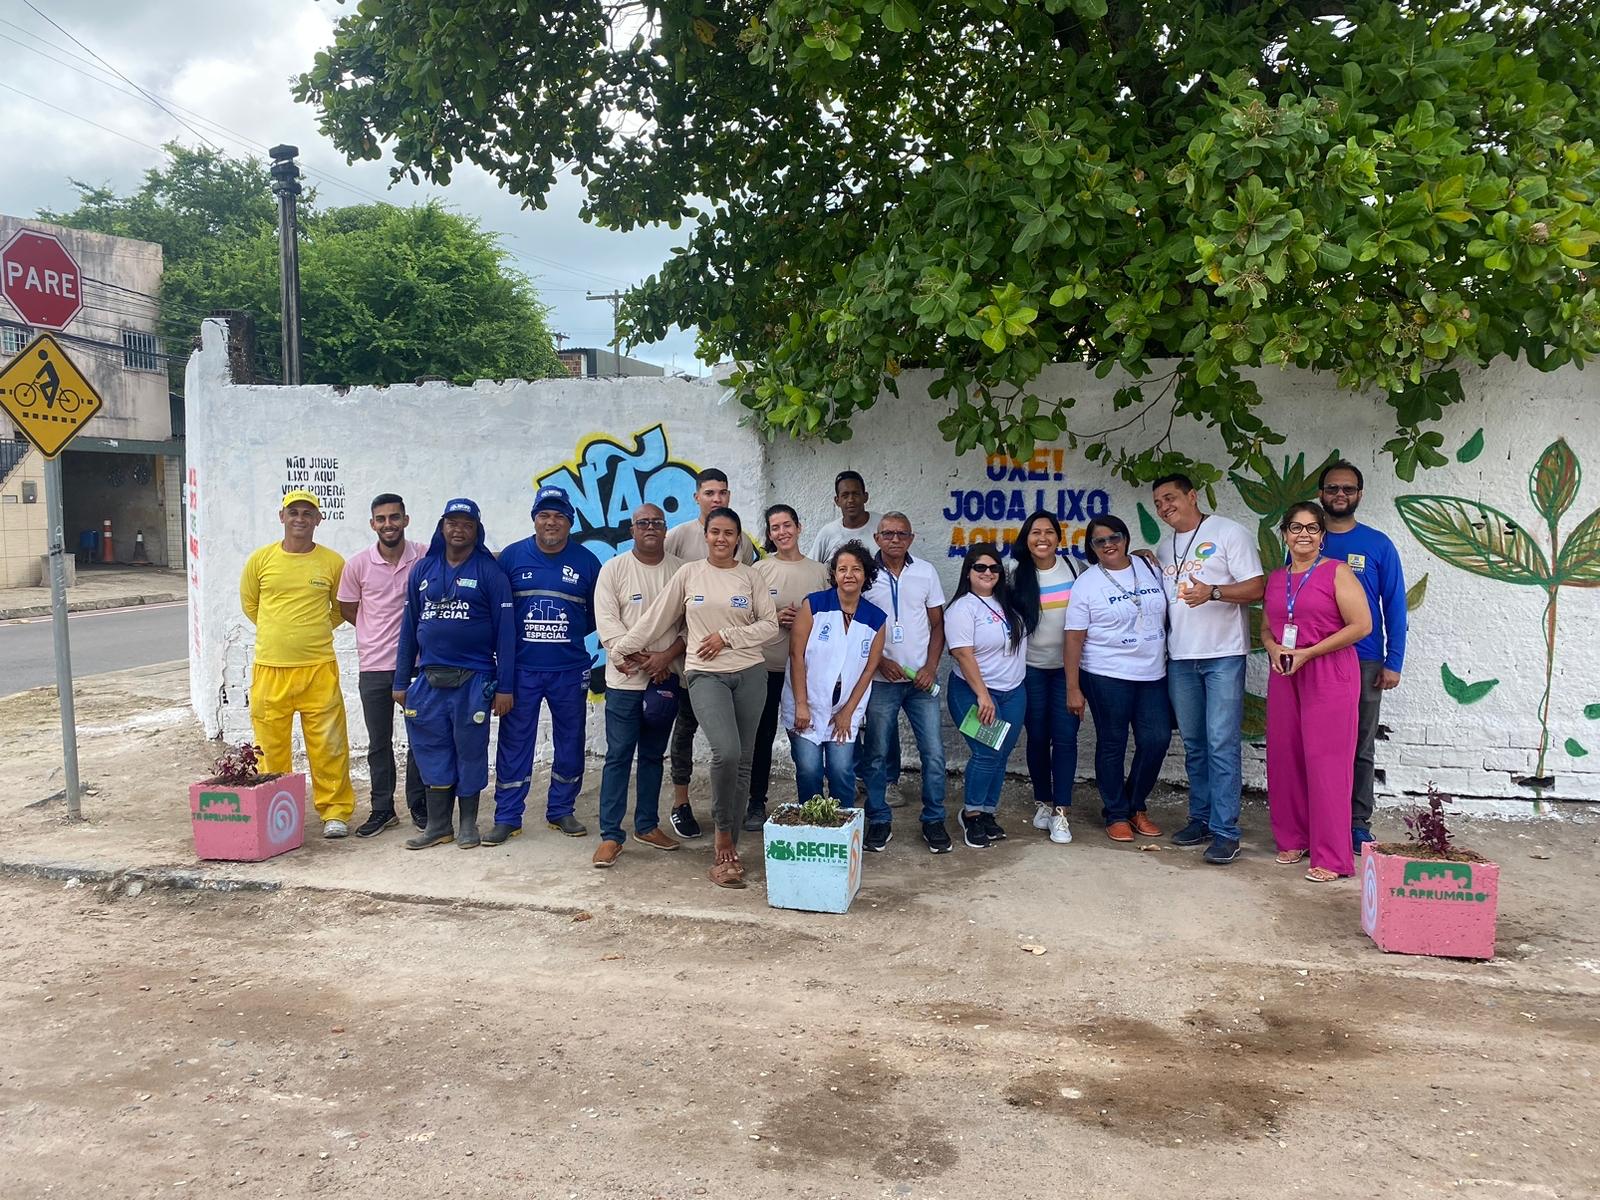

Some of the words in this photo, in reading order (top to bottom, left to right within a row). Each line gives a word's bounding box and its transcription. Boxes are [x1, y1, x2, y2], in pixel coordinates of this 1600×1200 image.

[7, 261, 76, 299] PARE
[286, 456, 306, 469] NÃO
[309, 457, 339, 469] JOGUE
[987, 448, 1065, 482] OXE!
[287, 470, 309, 482] LIXO
[314, 470, 336, 482] AQUI
[537, 424, 700, 538] NÃO
[308, 483, 345, 496] PODERÁ
[943, 489, 1027, 522] JOGA
[1036, 489, 1110, 522] LIXO
[522, 571, 533, 580] L2
[524, 622, 568, 635] OPERAÇÃO
[526, 631, 567, 640] ESPECIAL
[796, 841, 848, 860] RECIFE
[1409, 888, 1486, 903] APRUMADO
